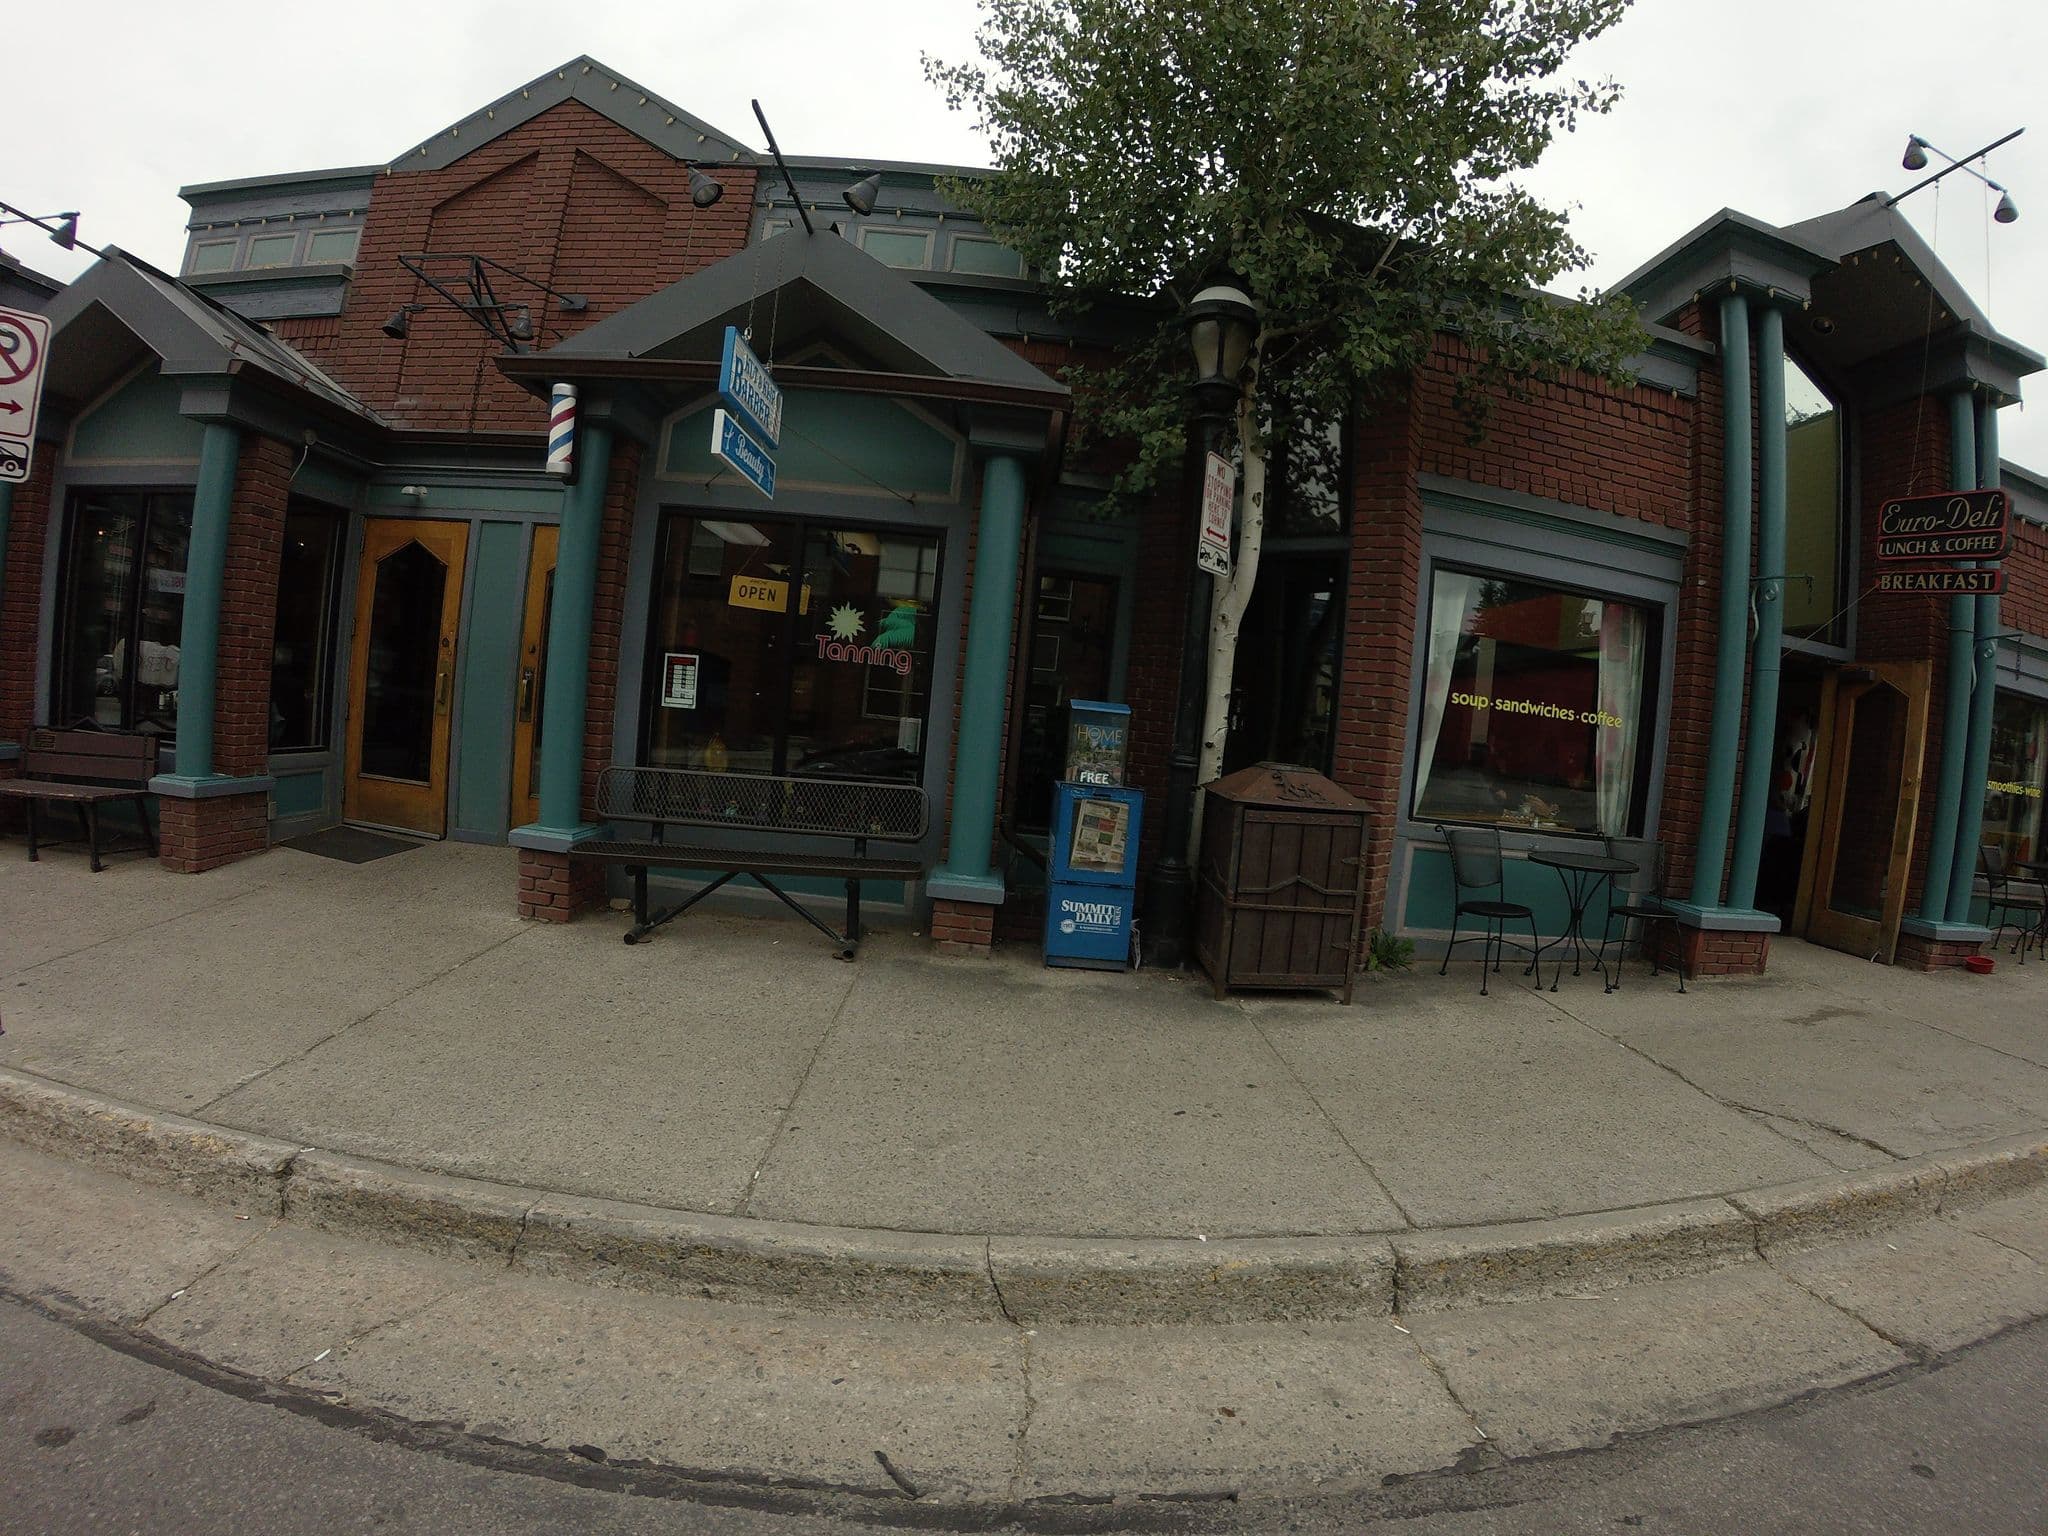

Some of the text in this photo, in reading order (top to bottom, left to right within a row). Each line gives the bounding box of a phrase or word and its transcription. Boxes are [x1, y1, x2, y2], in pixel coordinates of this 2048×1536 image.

[733, 356, 769, 428] BARBER
[736, 434, 765, 483] Beauty
[1217, 464, 1225, 479] NO
[1882, 494, 2003, 534] Euro-Deli
[1879, 536, 1998, 556] LUNCH & COFFEE
[1881, 573, 1993, 590] BREAKFAST
[738, 585, 777, 602] OPEN
[815, 634, 913, 676] Tanning
[1451, 692, 1623, 728] soup sandwiches coffee
[1077, 725, 1122, 744] HOME
[1080, 770, 1109, 785] FREE
[1061, 899, 1114, 915] SUMMIT
[1075, 912, 1114, 925] DAILY
